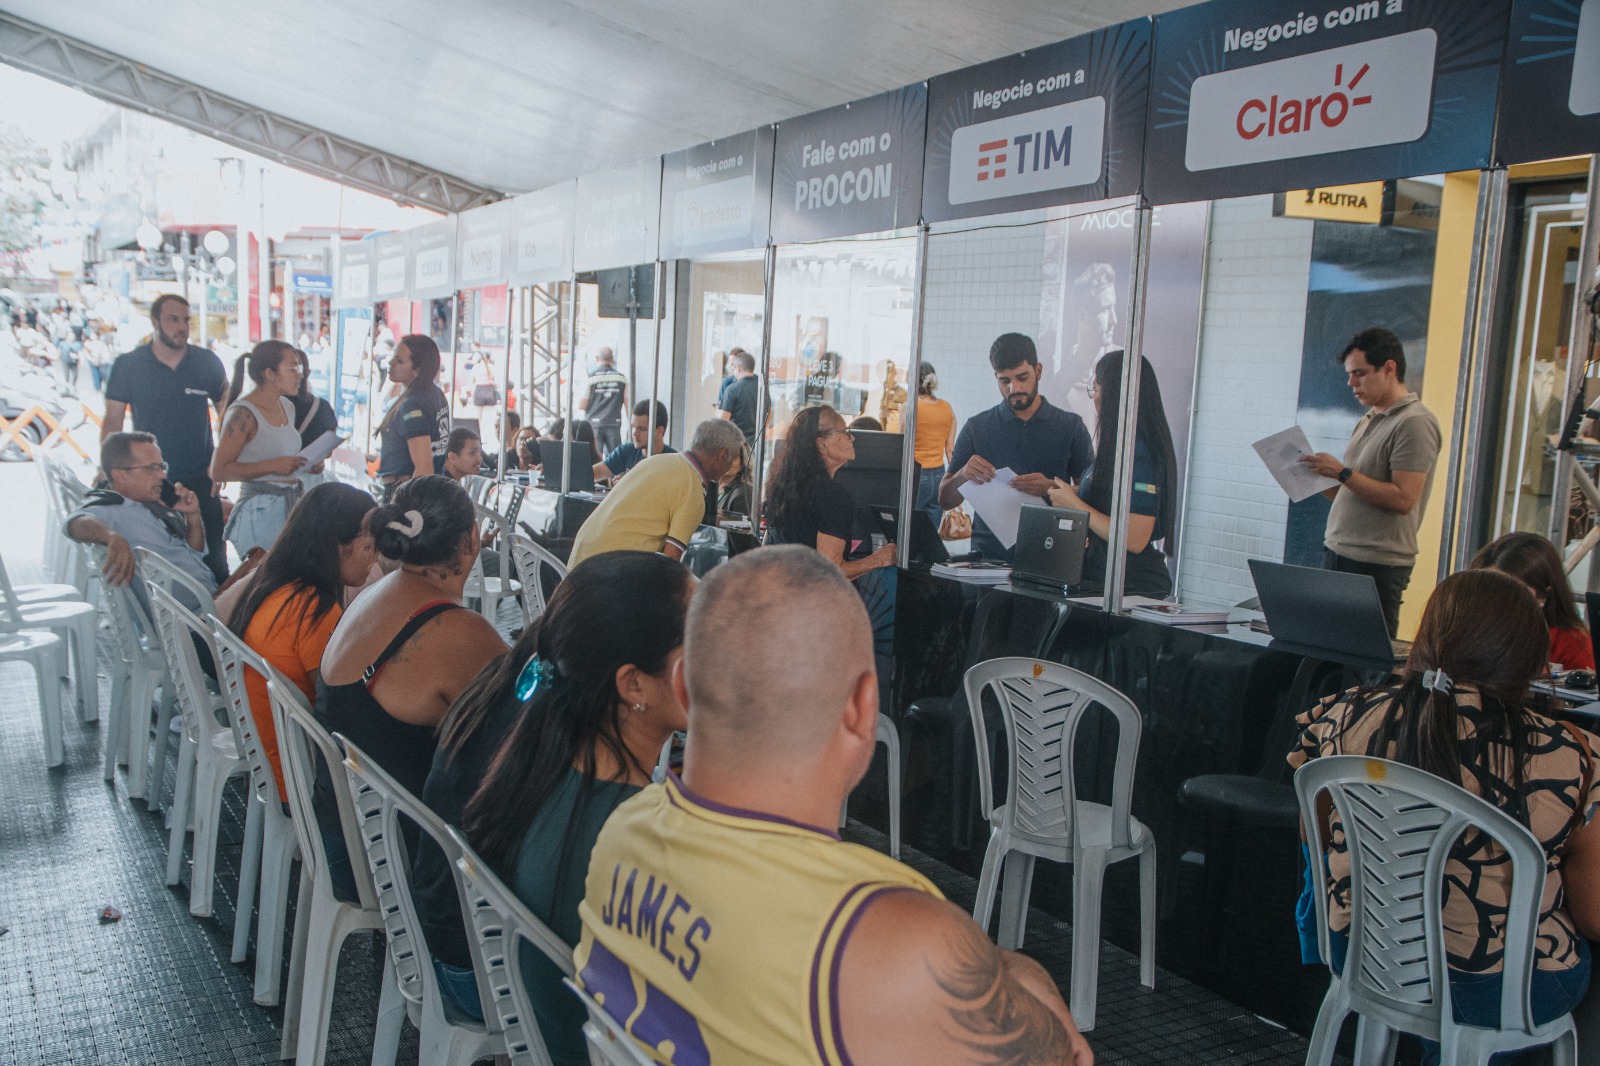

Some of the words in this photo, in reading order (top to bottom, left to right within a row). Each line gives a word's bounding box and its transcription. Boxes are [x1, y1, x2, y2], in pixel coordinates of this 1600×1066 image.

[1223, 12, 1319, 53] Negocie
[1324, 2, 1380, 30] com
[1384, 0, 1404, 15] a
[972, 81, 1032, 110] Negocie
[1036, 75, 1071, 95] com
[1074, 68, 1085, 85] a
[1235, 90, 1349, 140] Claro
[686, 160, 717, 180] Negocie
[719, 156, 736, 171] com
[737, 154, 743, 166] o
[802, 139, 835, 168] Fale
[838, 136, 875, 161] com
[879, 132, 891, 152] o
[1013, 125, 1073, 174] TIM
[795, 162, 892, 212] PROCON
[1318, 190, 1368, 208] RUTRA
[699, 204, 742, 225] bradesco
[1080, 206, 1162, 231] MIOCE
[602, 863, 712, 982] JAMES
